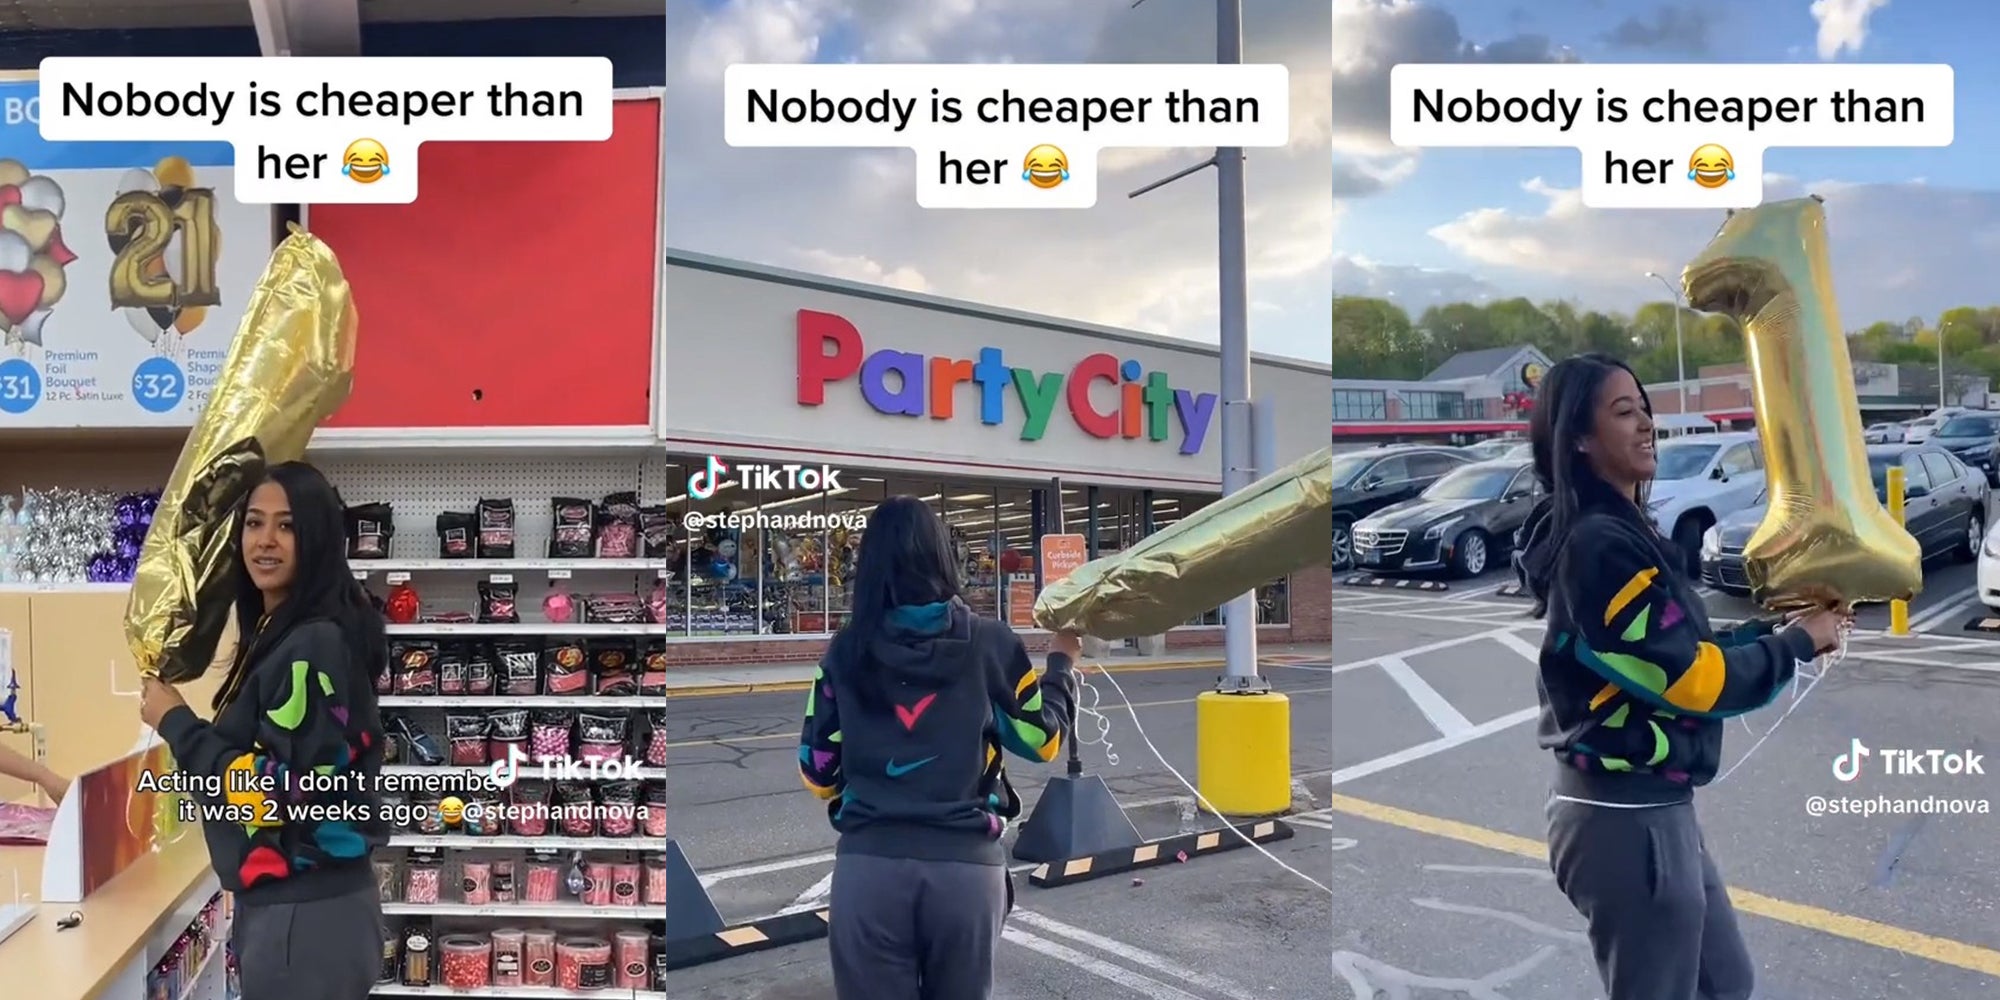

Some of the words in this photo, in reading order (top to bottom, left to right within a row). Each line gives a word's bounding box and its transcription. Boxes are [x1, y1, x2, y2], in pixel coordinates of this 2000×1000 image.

[45, 350, 99, 361] Premium
[45, 363, 67, 374] Foil
[45, 376, 97, 391] Bouquet
[134, 374, 178, 399] $32
[45, 391, 57, 401] 12
[75, 390, 99, 401] Satin
[101, 391, 124, 401] Luxe
[187, 390, 194, 400] 2
[1047, 549, 1082, 560] Curbside
